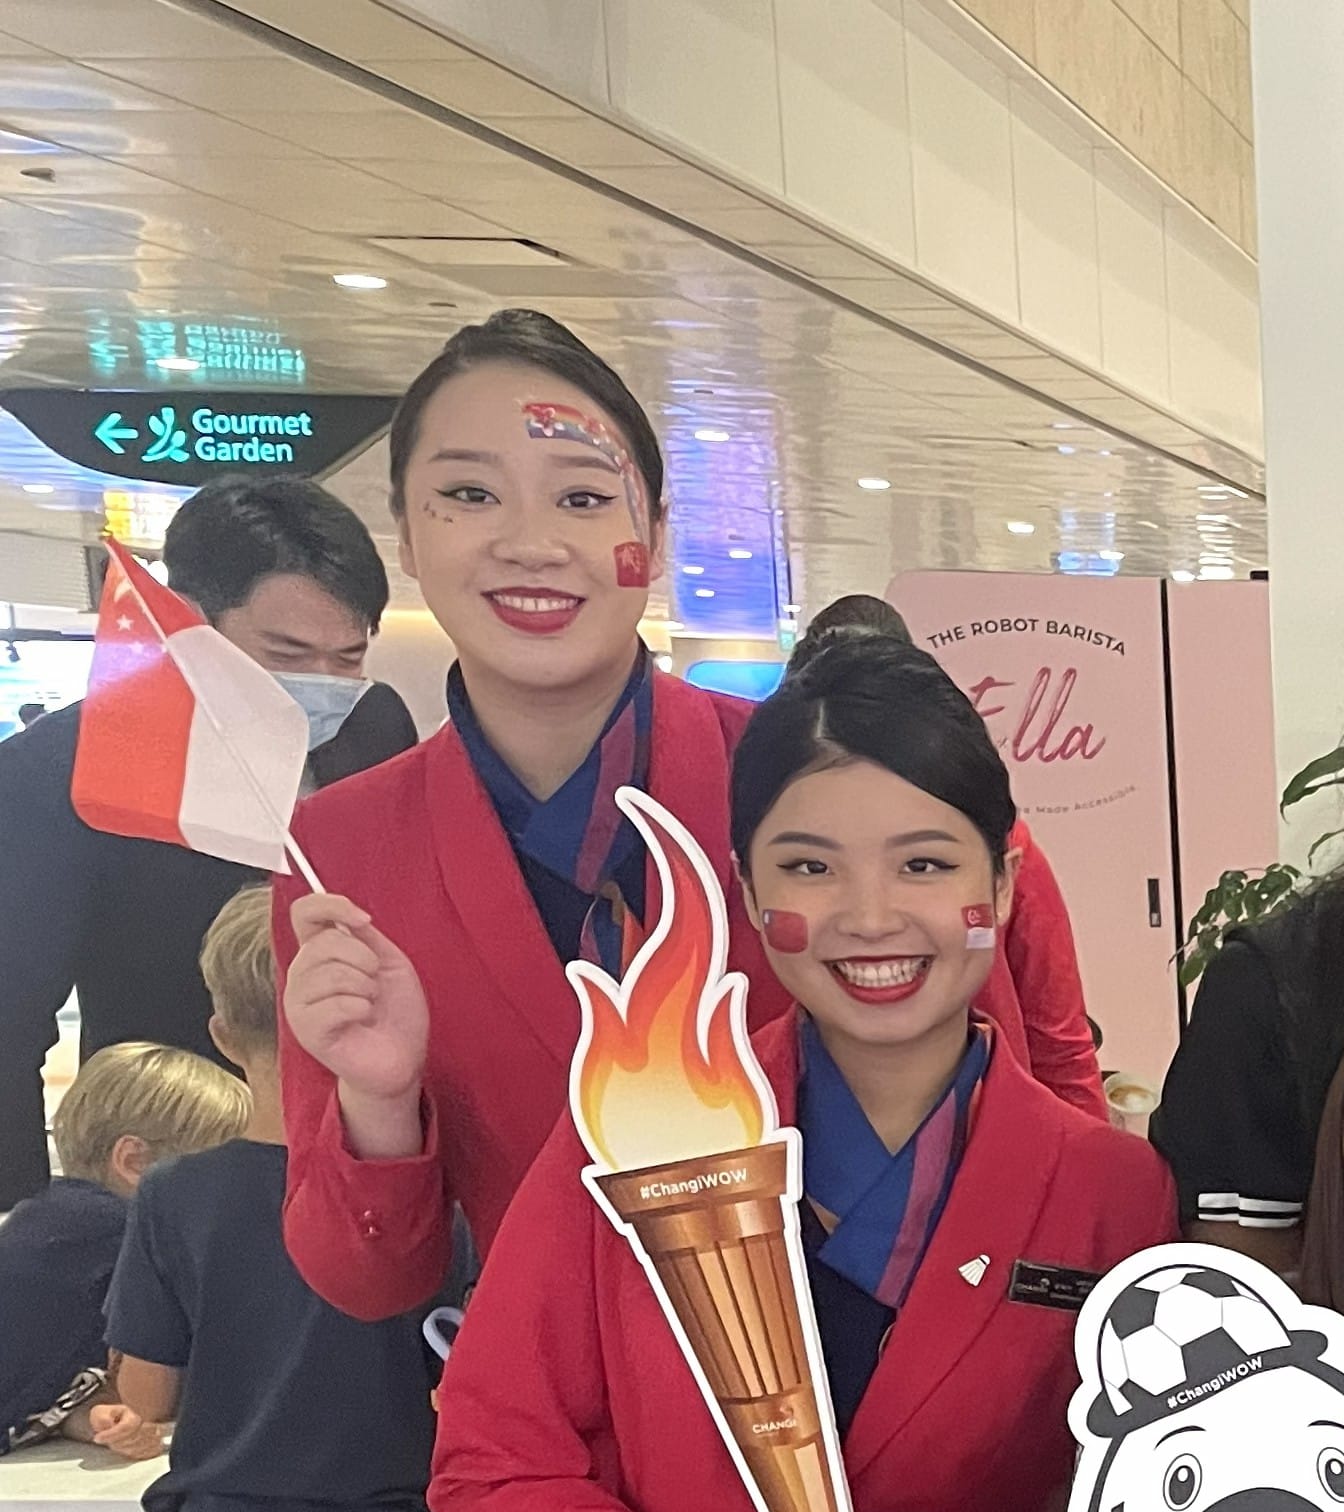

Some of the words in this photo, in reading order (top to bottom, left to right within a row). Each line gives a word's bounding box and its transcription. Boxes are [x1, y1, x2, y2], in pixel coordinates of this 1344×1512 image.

[192, 407, 313, 436] Gourmet
[194, 436, 294, 462] Garden
[926, 625, 967, 650] THE
[970, 617, 1040, 637] ROBOT
[1045, 619, 1126, 657] BARISTA
[639, 1167, 748, 1200] #ChangiWOW
[1166, 1355, 1263, 1409] #ChangiWOW
[752, 1418, 797, 1434] CHANGI
